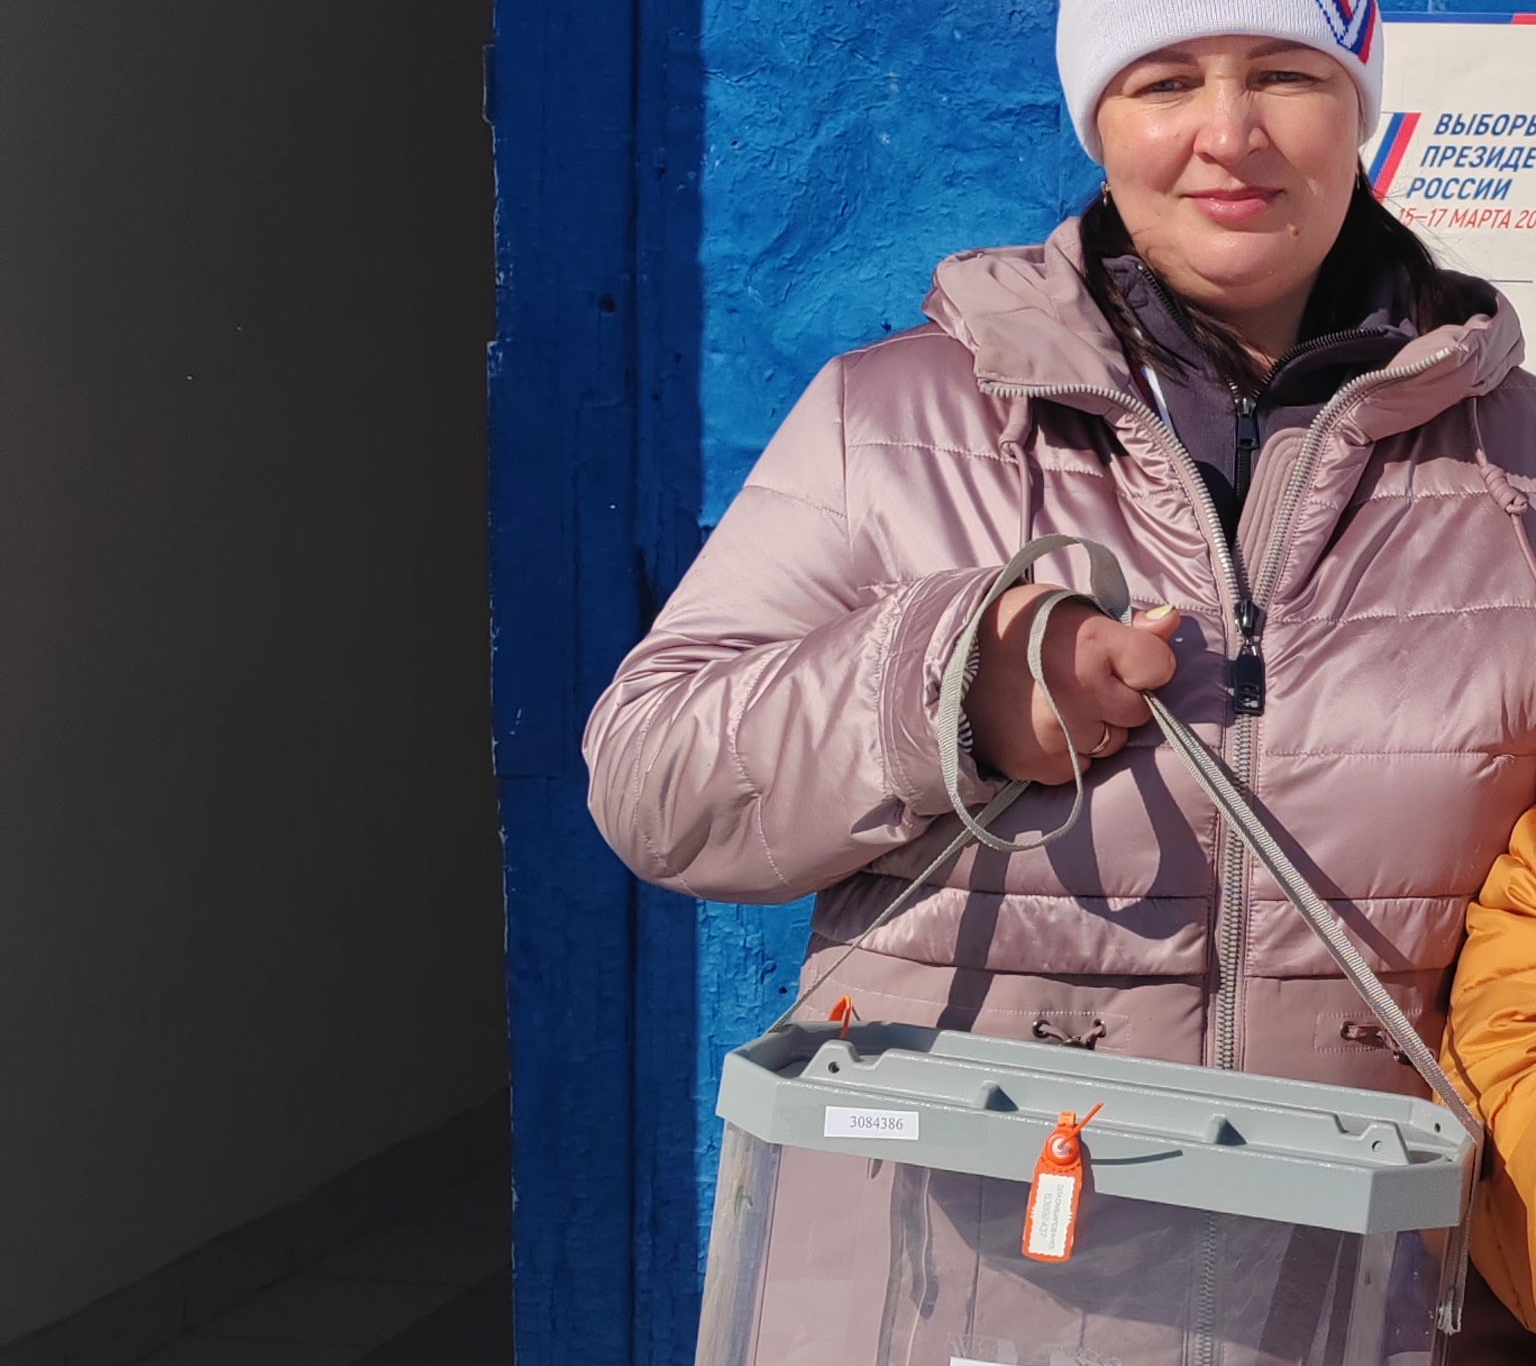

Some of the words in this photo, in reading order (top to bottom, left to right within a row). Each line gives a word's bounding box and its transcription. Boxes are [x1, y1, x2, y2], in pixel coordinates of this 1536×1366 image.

[1406, 177, 1513, 201] РОССИИ
[1448, 208, 1511, 229] МАРТА
[849, 1115, 904, 1131] 3084386
